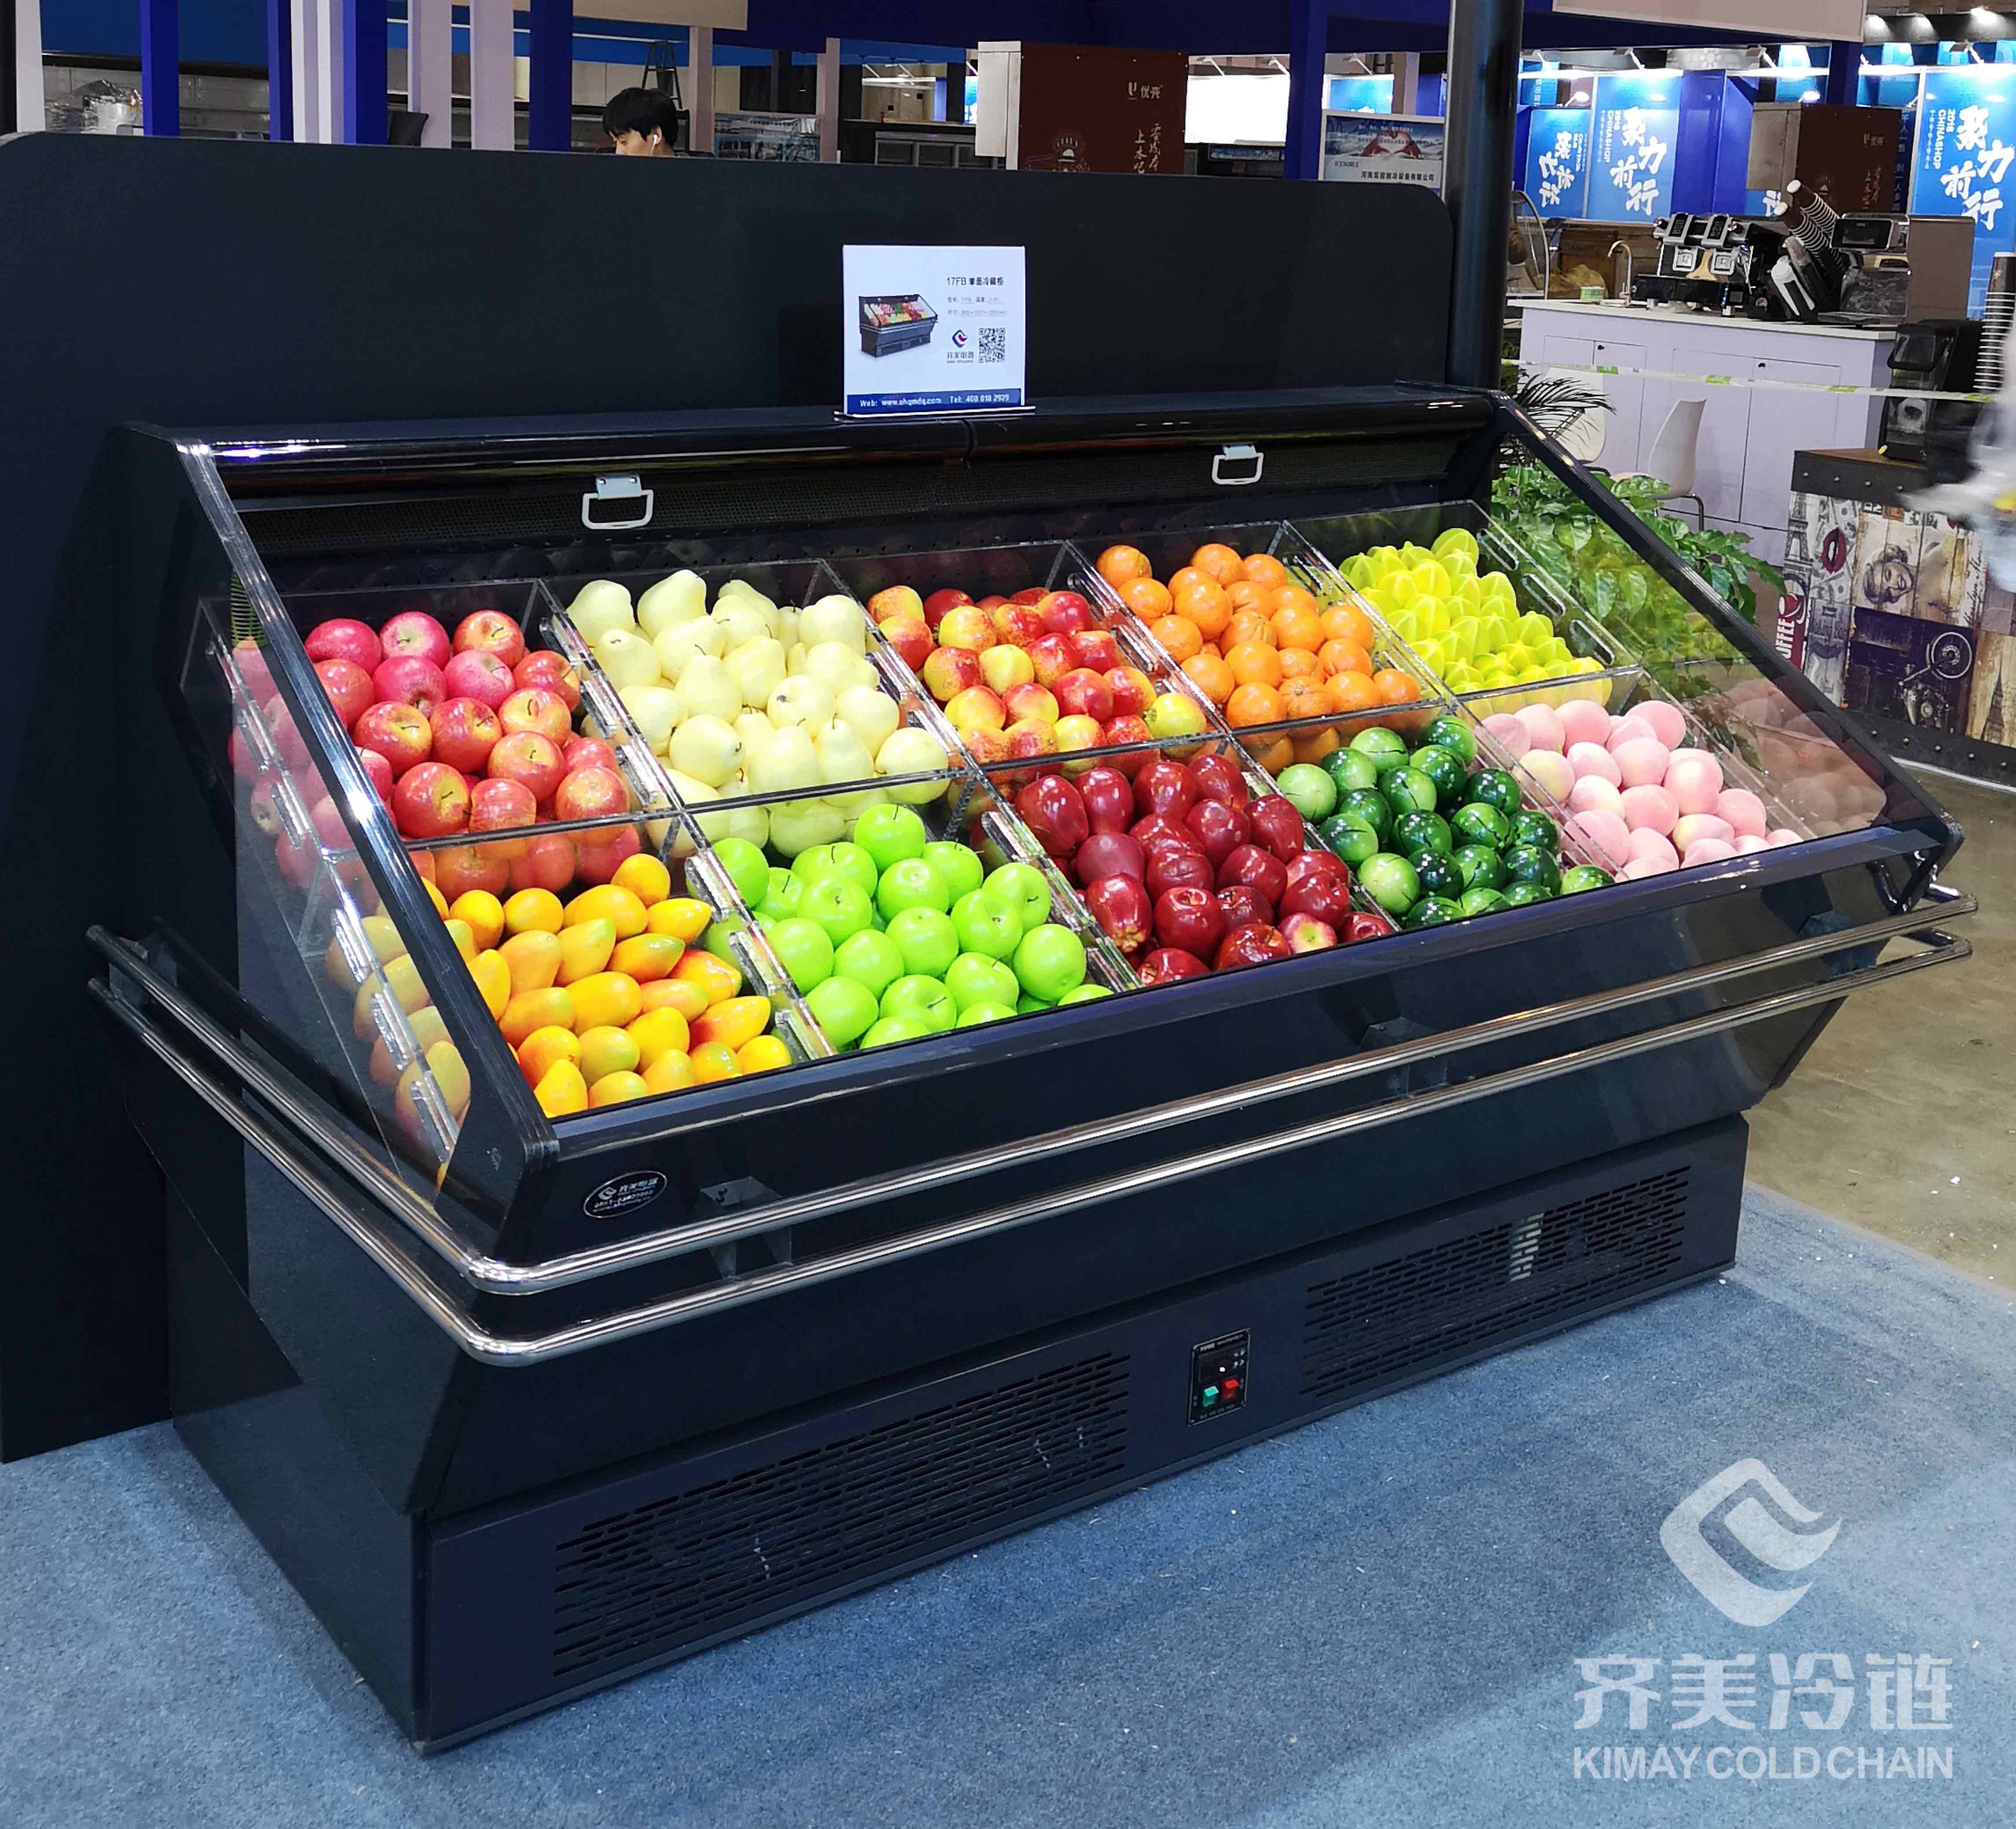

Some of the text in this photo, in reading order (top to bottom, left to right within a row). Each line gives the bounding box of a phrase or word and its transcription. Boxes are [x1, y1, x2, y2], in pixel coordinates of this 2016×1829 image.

[1933, 109, 1947, 169] CHINASHOP
[947, 277, 967, 285] 17FB
[950, 395, 962, 404] Tel:
